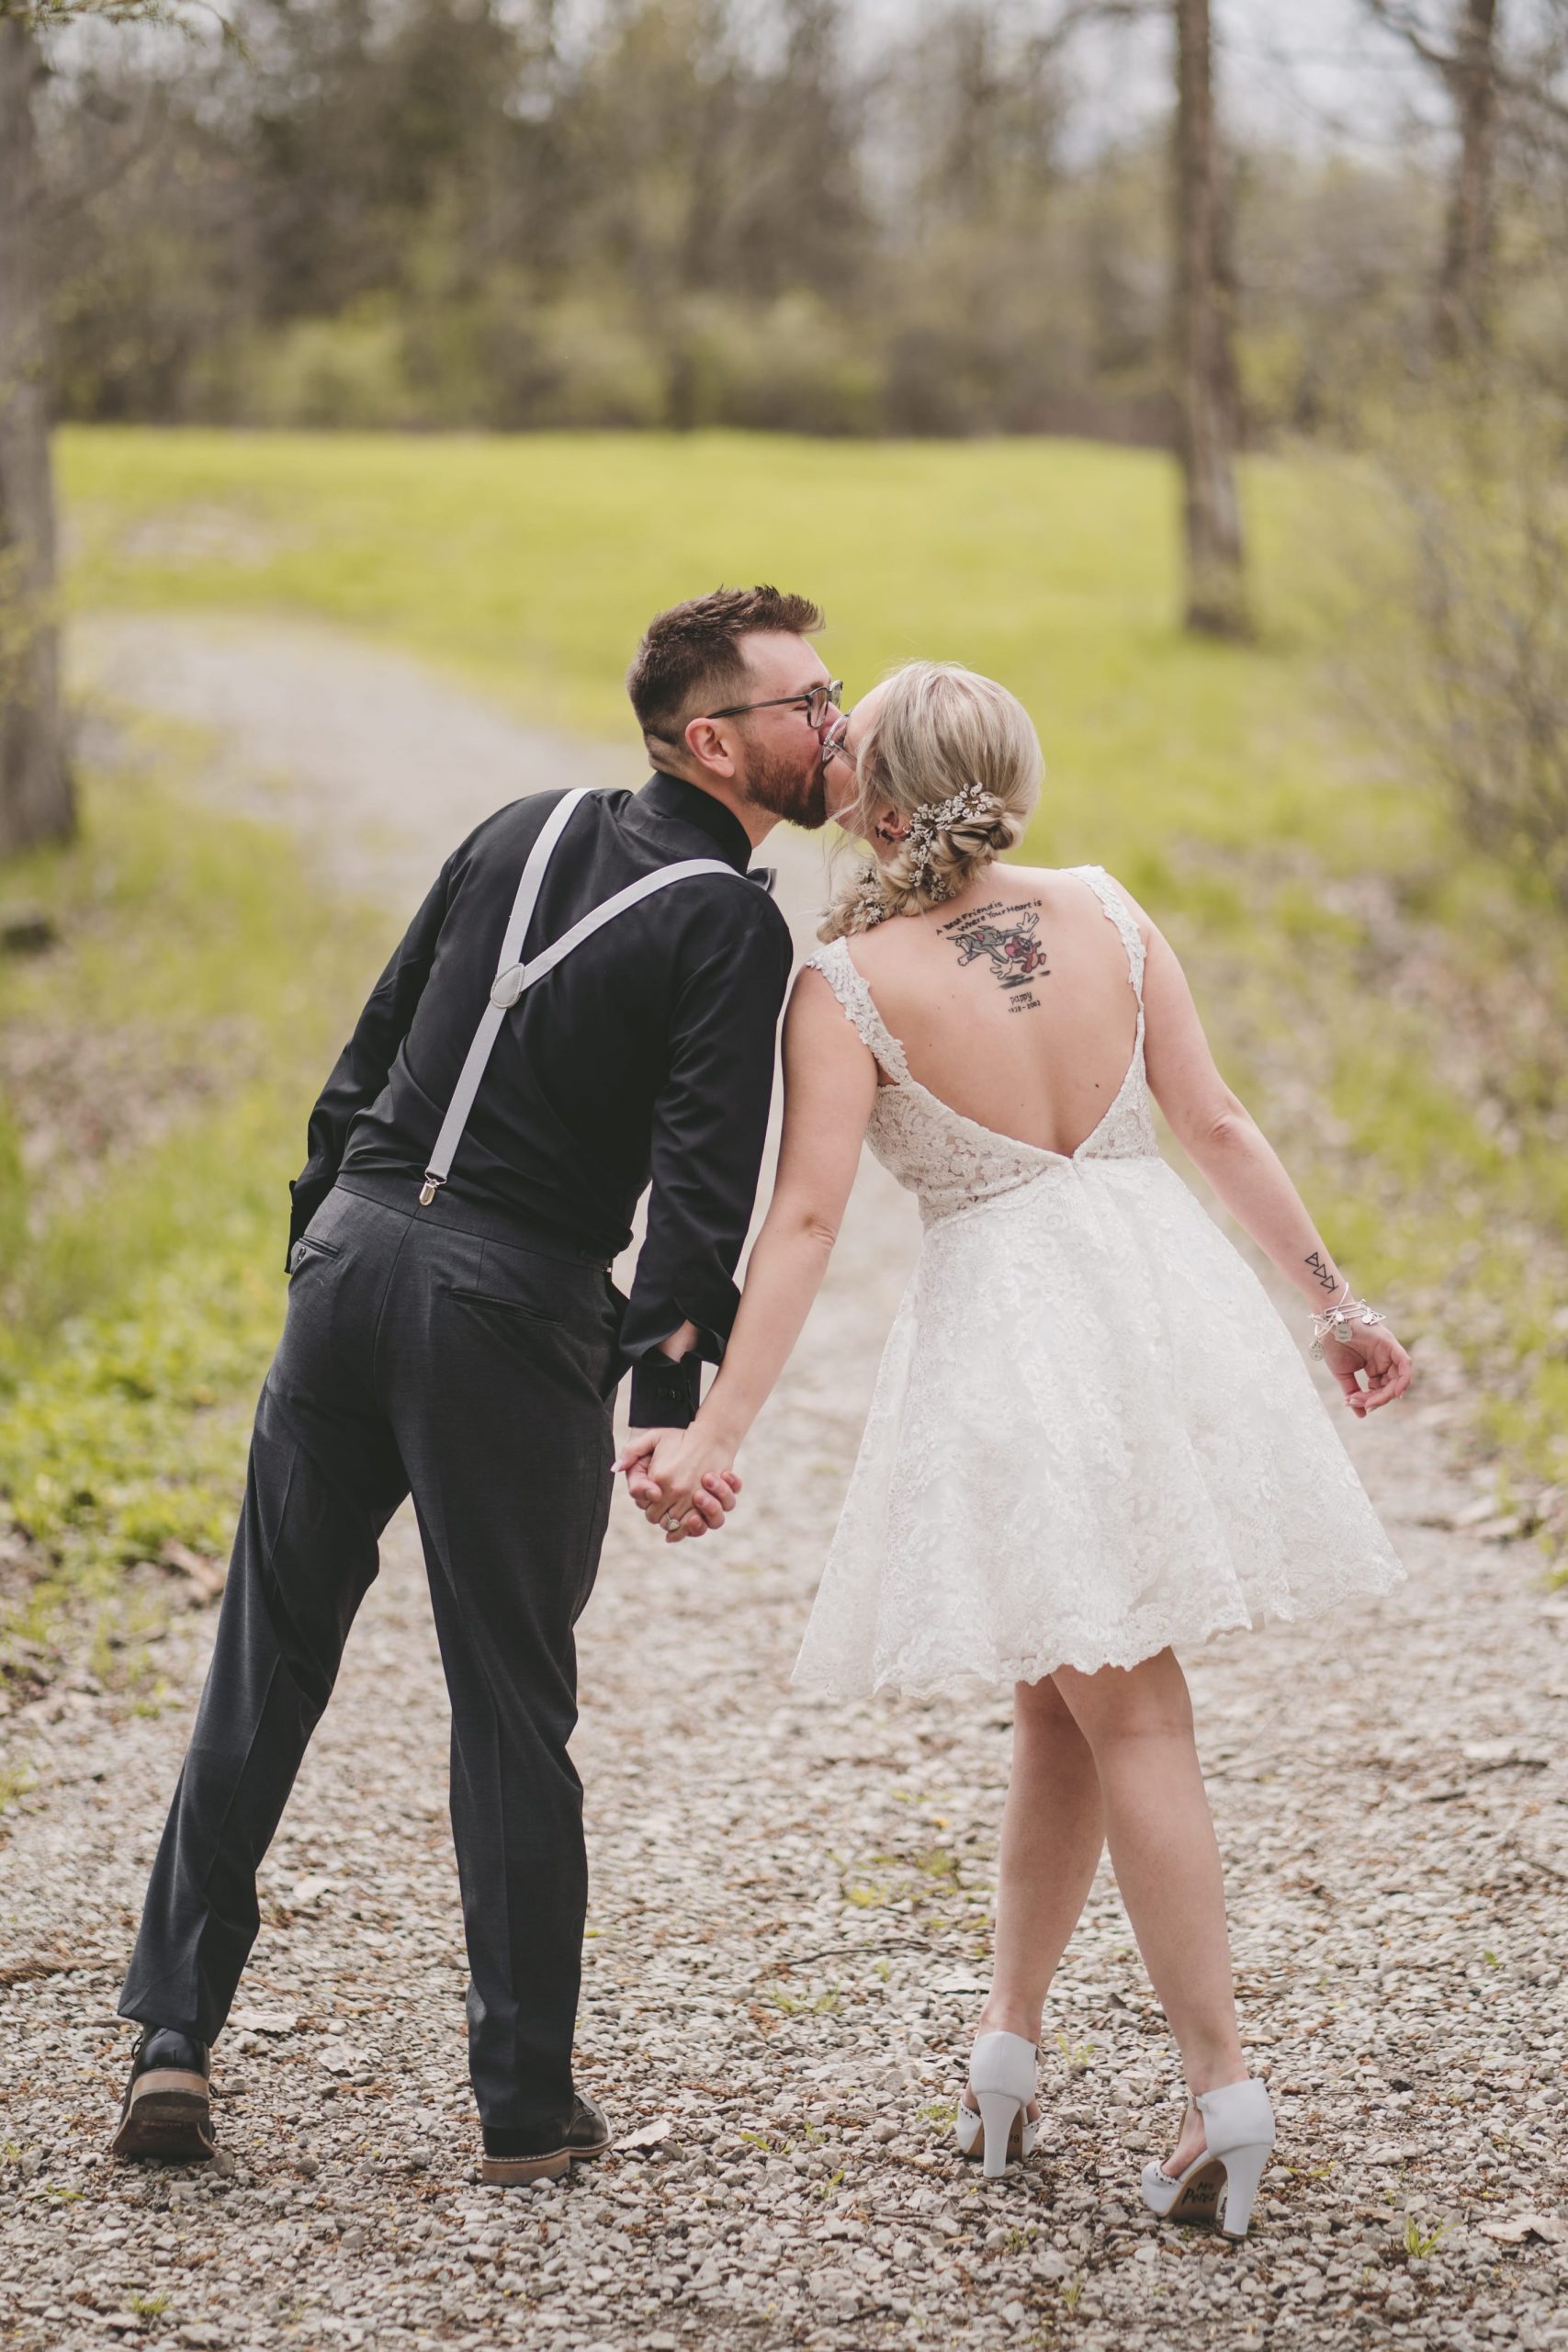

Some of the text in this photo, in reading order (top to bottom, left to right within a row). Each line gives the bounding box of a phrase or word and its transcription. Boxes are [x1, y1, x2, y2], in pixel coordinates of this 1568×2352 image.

[942, 919, 963, 931] Best
[962, 903, 993, 920] Friend
[993, 900, 1003, 909] is
[957, 899, 1043, 932] Where Your Heart is
